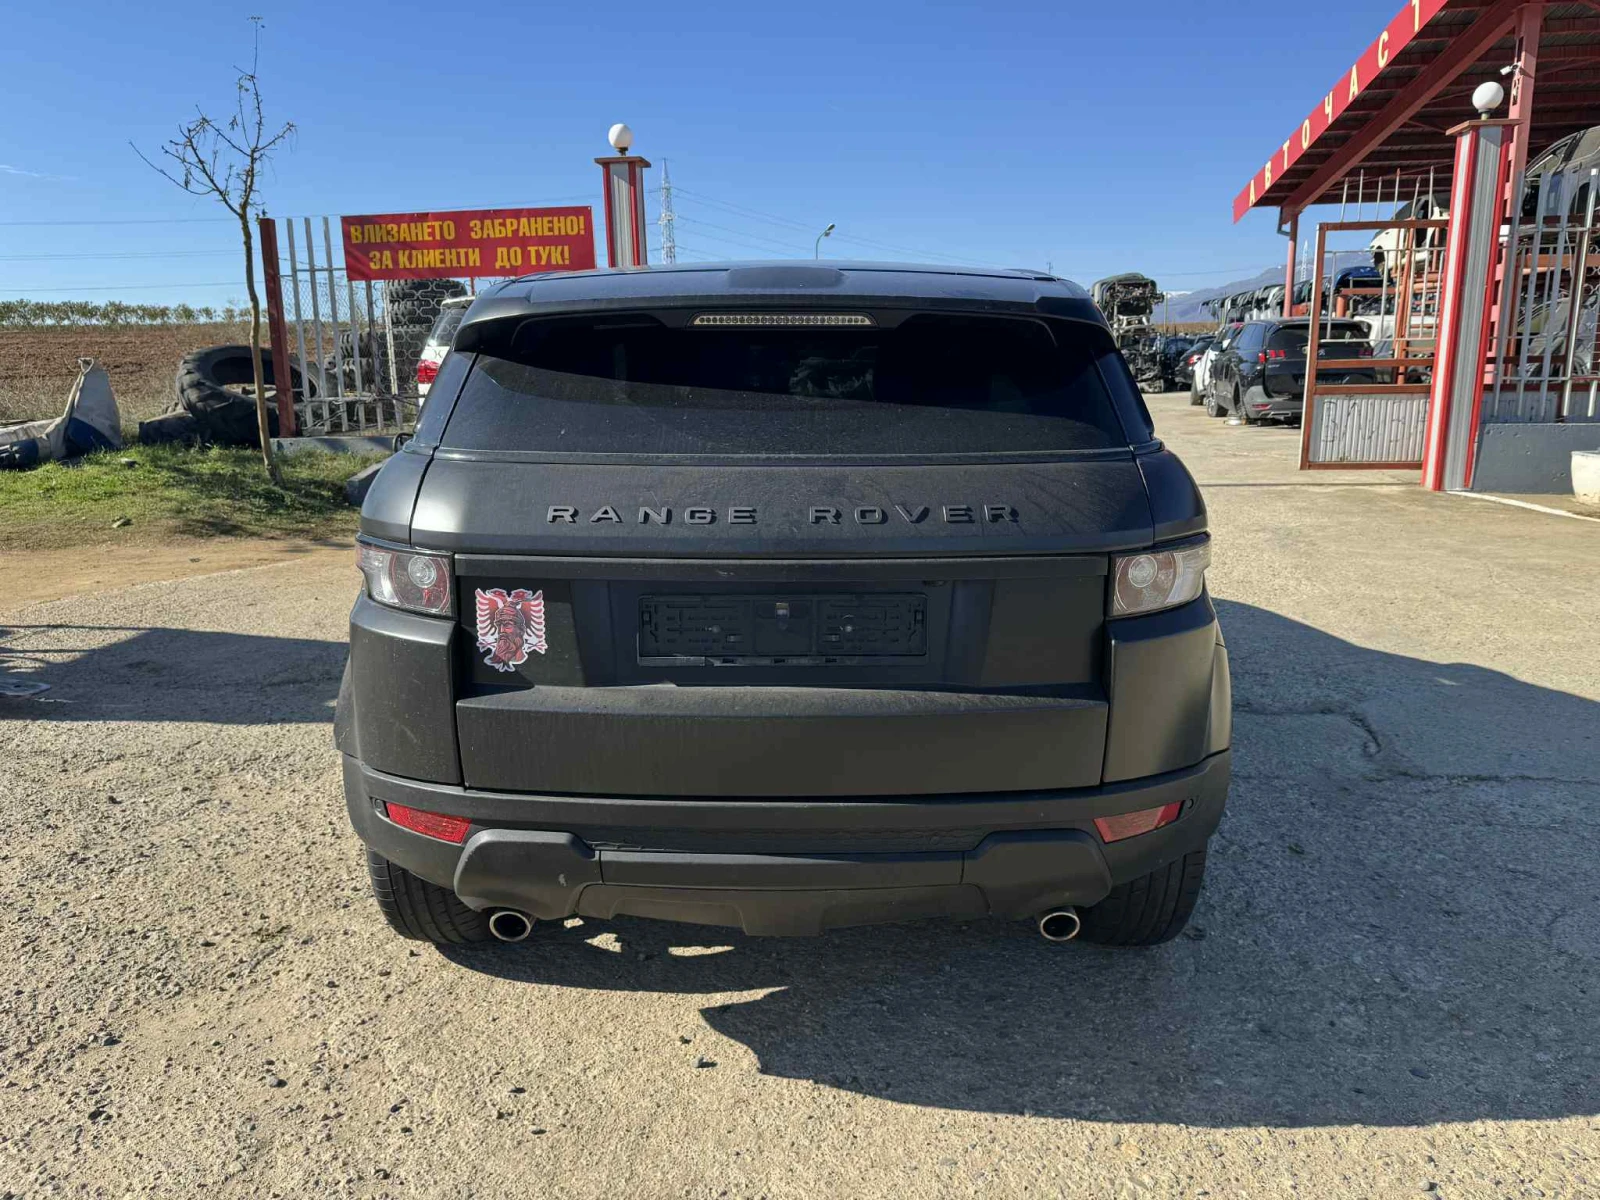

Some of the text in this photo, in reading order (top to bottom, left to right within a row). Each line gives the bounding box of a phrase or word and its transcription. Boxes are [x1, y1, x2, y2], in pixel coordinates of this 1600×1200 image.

[350, 215, 586, 244] ВЛИЗАНЕТО ЗАБРАНЕНО!
[368, 251, 393, 270] ЗА
[495, 247, 522, 269] ДО
[527, 245, 570, 266] ТУК!
[546, 504, 1019, 526] RANGE ROVER
